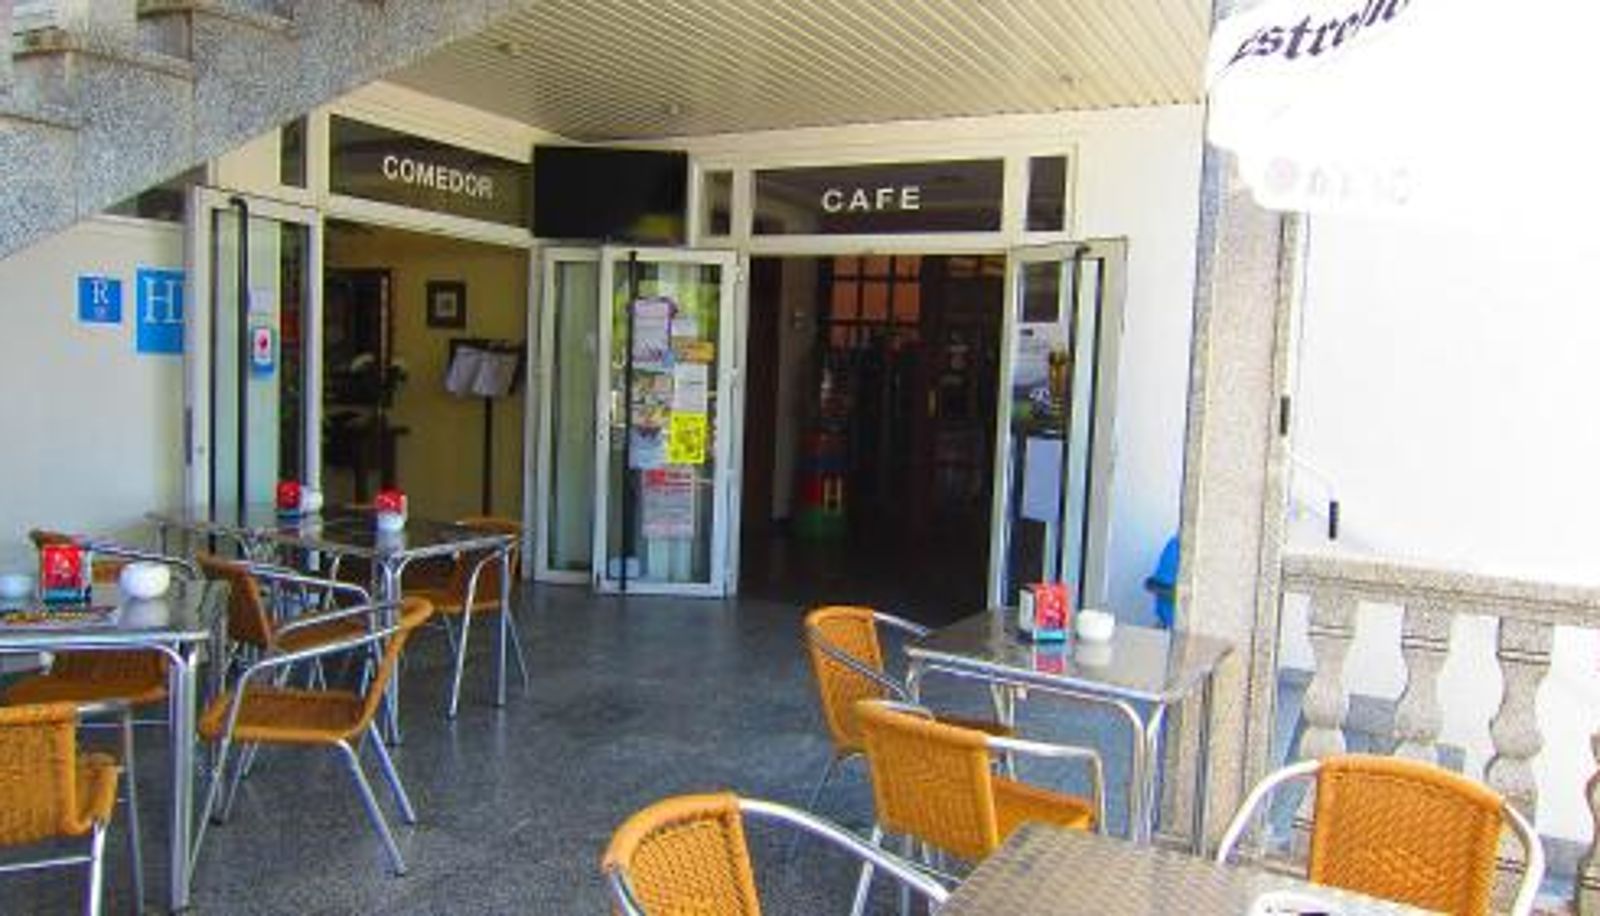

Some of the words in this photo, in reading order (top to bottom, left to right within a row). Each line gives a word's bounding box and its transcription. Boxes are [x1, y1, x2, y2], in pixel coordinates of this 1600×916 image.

[382, 154, 494, 201] COMEDOR
[821, 185, 922, 213] CAFE
[92, 280, 109, 305] R
[143, 276, 185, 324] H
